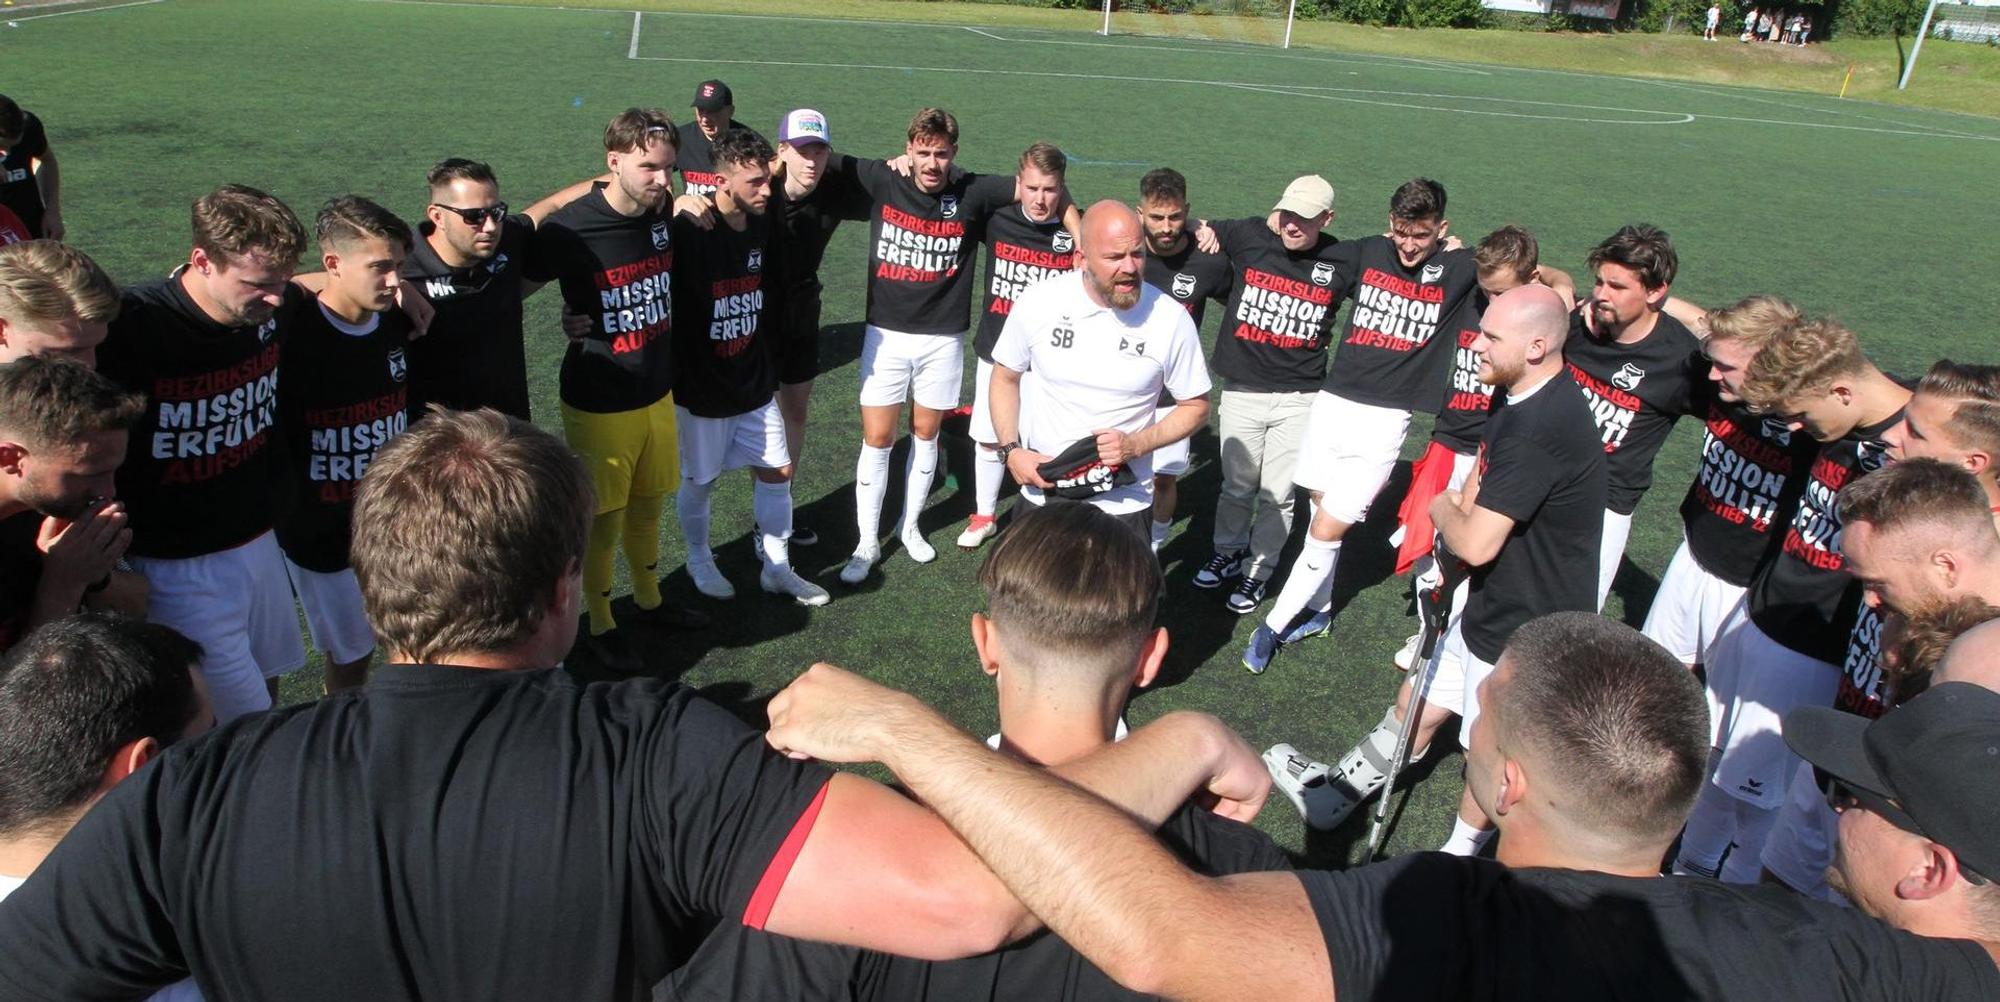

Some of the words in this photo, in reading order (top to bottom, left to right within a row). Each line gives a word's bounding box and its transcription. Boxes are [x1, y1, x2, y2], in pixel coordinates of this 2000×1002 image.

[881, 222, 962, 253] MISSION
[882, 204, 966, 237] BEZIRKSLIGA
[995, 240, 1074, 269] BEZIRKSLIG
[425, 279, 456, 299] MK
[601, 271, 671, 310] MISSIO
[1245, 267, 1334, 305] BEZIRKSLIGA
[1361, 267, 1444, 303] BEZIRKSLIGA
[713, 289, 763, 319] MISSIO
[1241, 285, 1327, 323] MISSION
[1358, 284, 1441, 324] MISSION
[1051, 327, 1074, 349] SB
[311, 408, 408, 454] MISSIO
[1703, 426, 1787, 499] ISSION
